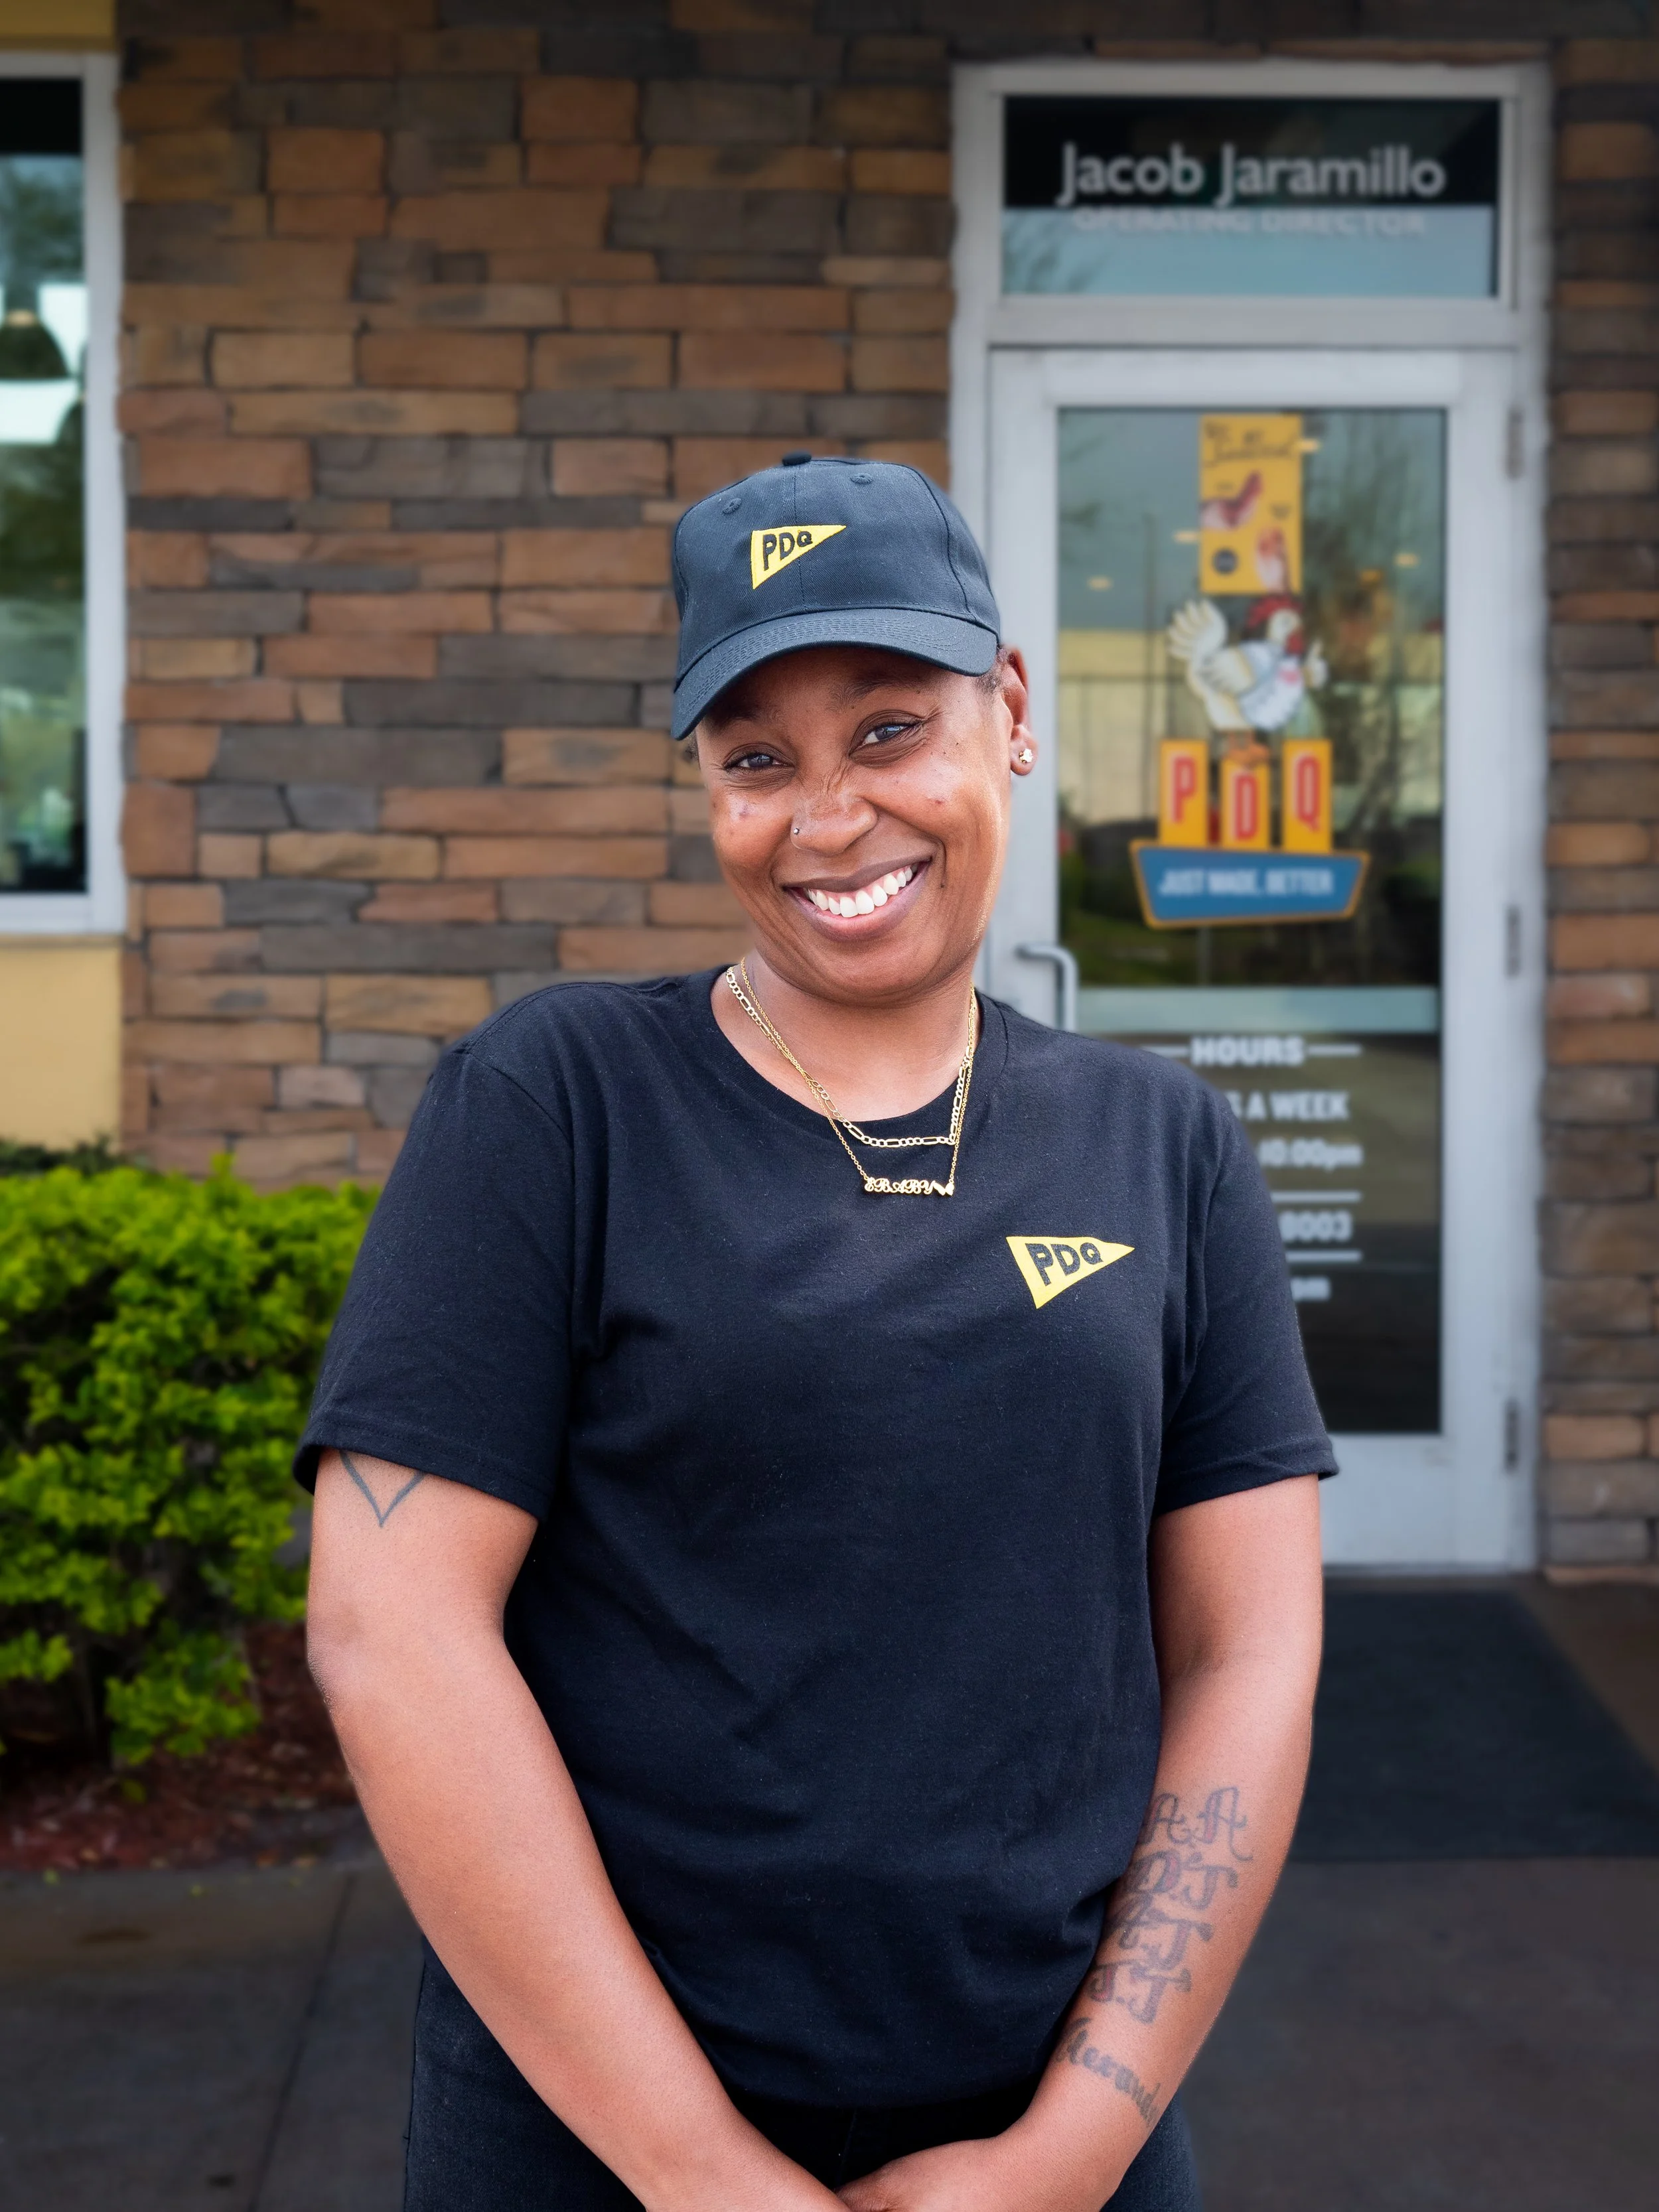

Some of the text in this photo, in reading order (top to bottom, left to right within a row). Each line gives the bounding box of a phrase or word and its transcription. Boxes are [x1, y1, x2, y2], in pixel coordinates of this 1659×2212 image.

[1056, 143, 1446, 207] Jacob Jaramillo
[1072, 206, 1425, 236] OPERATING DIRECTOR
[762, 531, 814, 571] PDQ
[1190, 1036, 1305, 1066] HOURS
[1246, 1090, 1267, 1120] A
[1269, 1089, 1350, 1121] WEEK
[1025, 1242, 1103, 1286] PDQ
